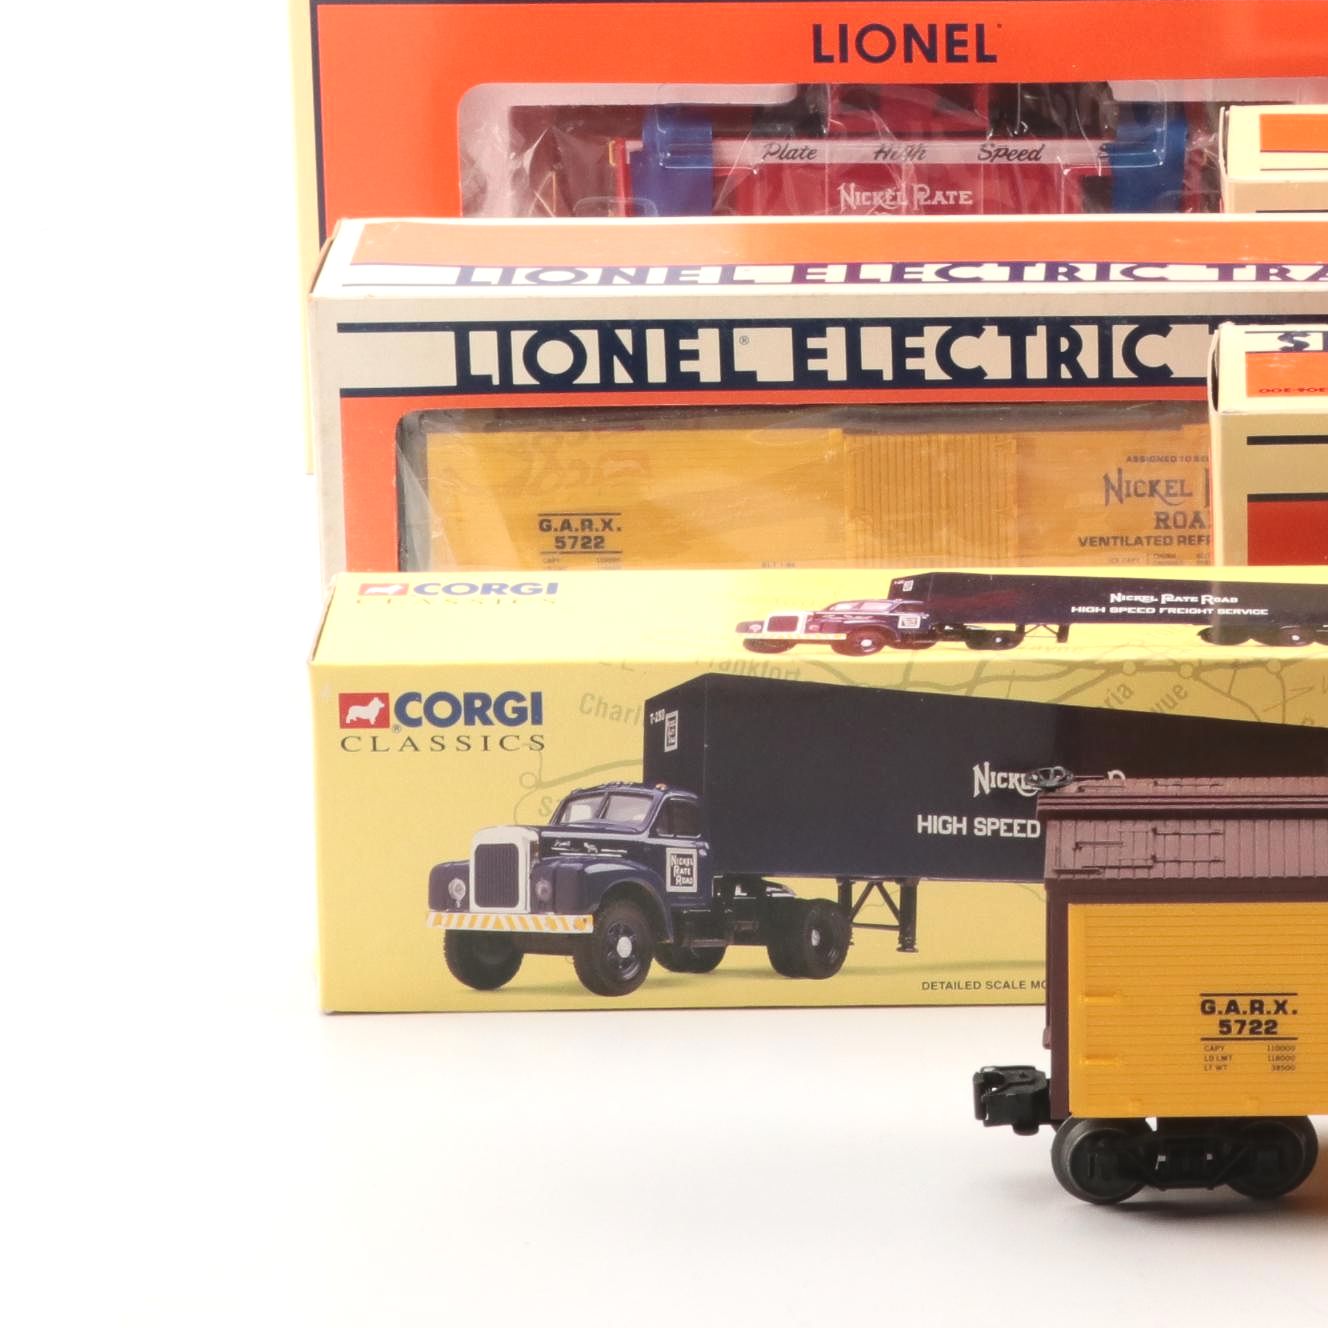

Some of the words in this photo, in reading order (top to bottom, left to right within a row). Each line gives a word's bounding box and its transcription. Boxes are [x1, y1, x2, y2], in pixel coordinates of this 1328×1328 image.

[812, 23, 999, 64] LIONEL
[763, 142, 818, 162] Plate
[977, 143, 1046, 163] Speed
[838, 182, 907, 210] NICKEL
[455, 265, 756, 285] LIONEL
[792, 262, 1168, 283] ELECTRIC
[455, 321, 758, 388] LIONEL
[792, 318, 1174, 387] ELECTRIC
[1126, 455, 1178, 463] ASSIGNED
[1103, 468, 1193, 507] NICKEL
[539, 518, 622, 532] G.A.R.X.
[1154, 511, 1211, 530] ROA
[555, 536, 605, 549] 5722
[1078, 535, 1174, 547] VENTILATED
[413, 582, 558, 596] CORGI
[1110, 593, 1158, 604] NICKEL
[1161, 593, 1199, 604] PLATE
[1201, 594, 1238, 604] ROAD
[1071, 606, 1106, 614] HIGH
[1110, 606, 1156, 614] SPEED
[1160, 607, 1214, 615] FREIGHT
[394, 691, 544, 728] CORGI
[341, 736, 545, 753] CLASSICS
[972, 761, 1042, 798] NICK
[917, 814, 967, 836] HIGH
[974, 817, 1041, 838] SPEED
[921, 981, 982, 991] DETAILED
[985, 981, 1027, 990] SCALE
[1200, 999, 1298, 1015] G.A.R.X.
[1218, 1019, 1278, 1035] 5722
